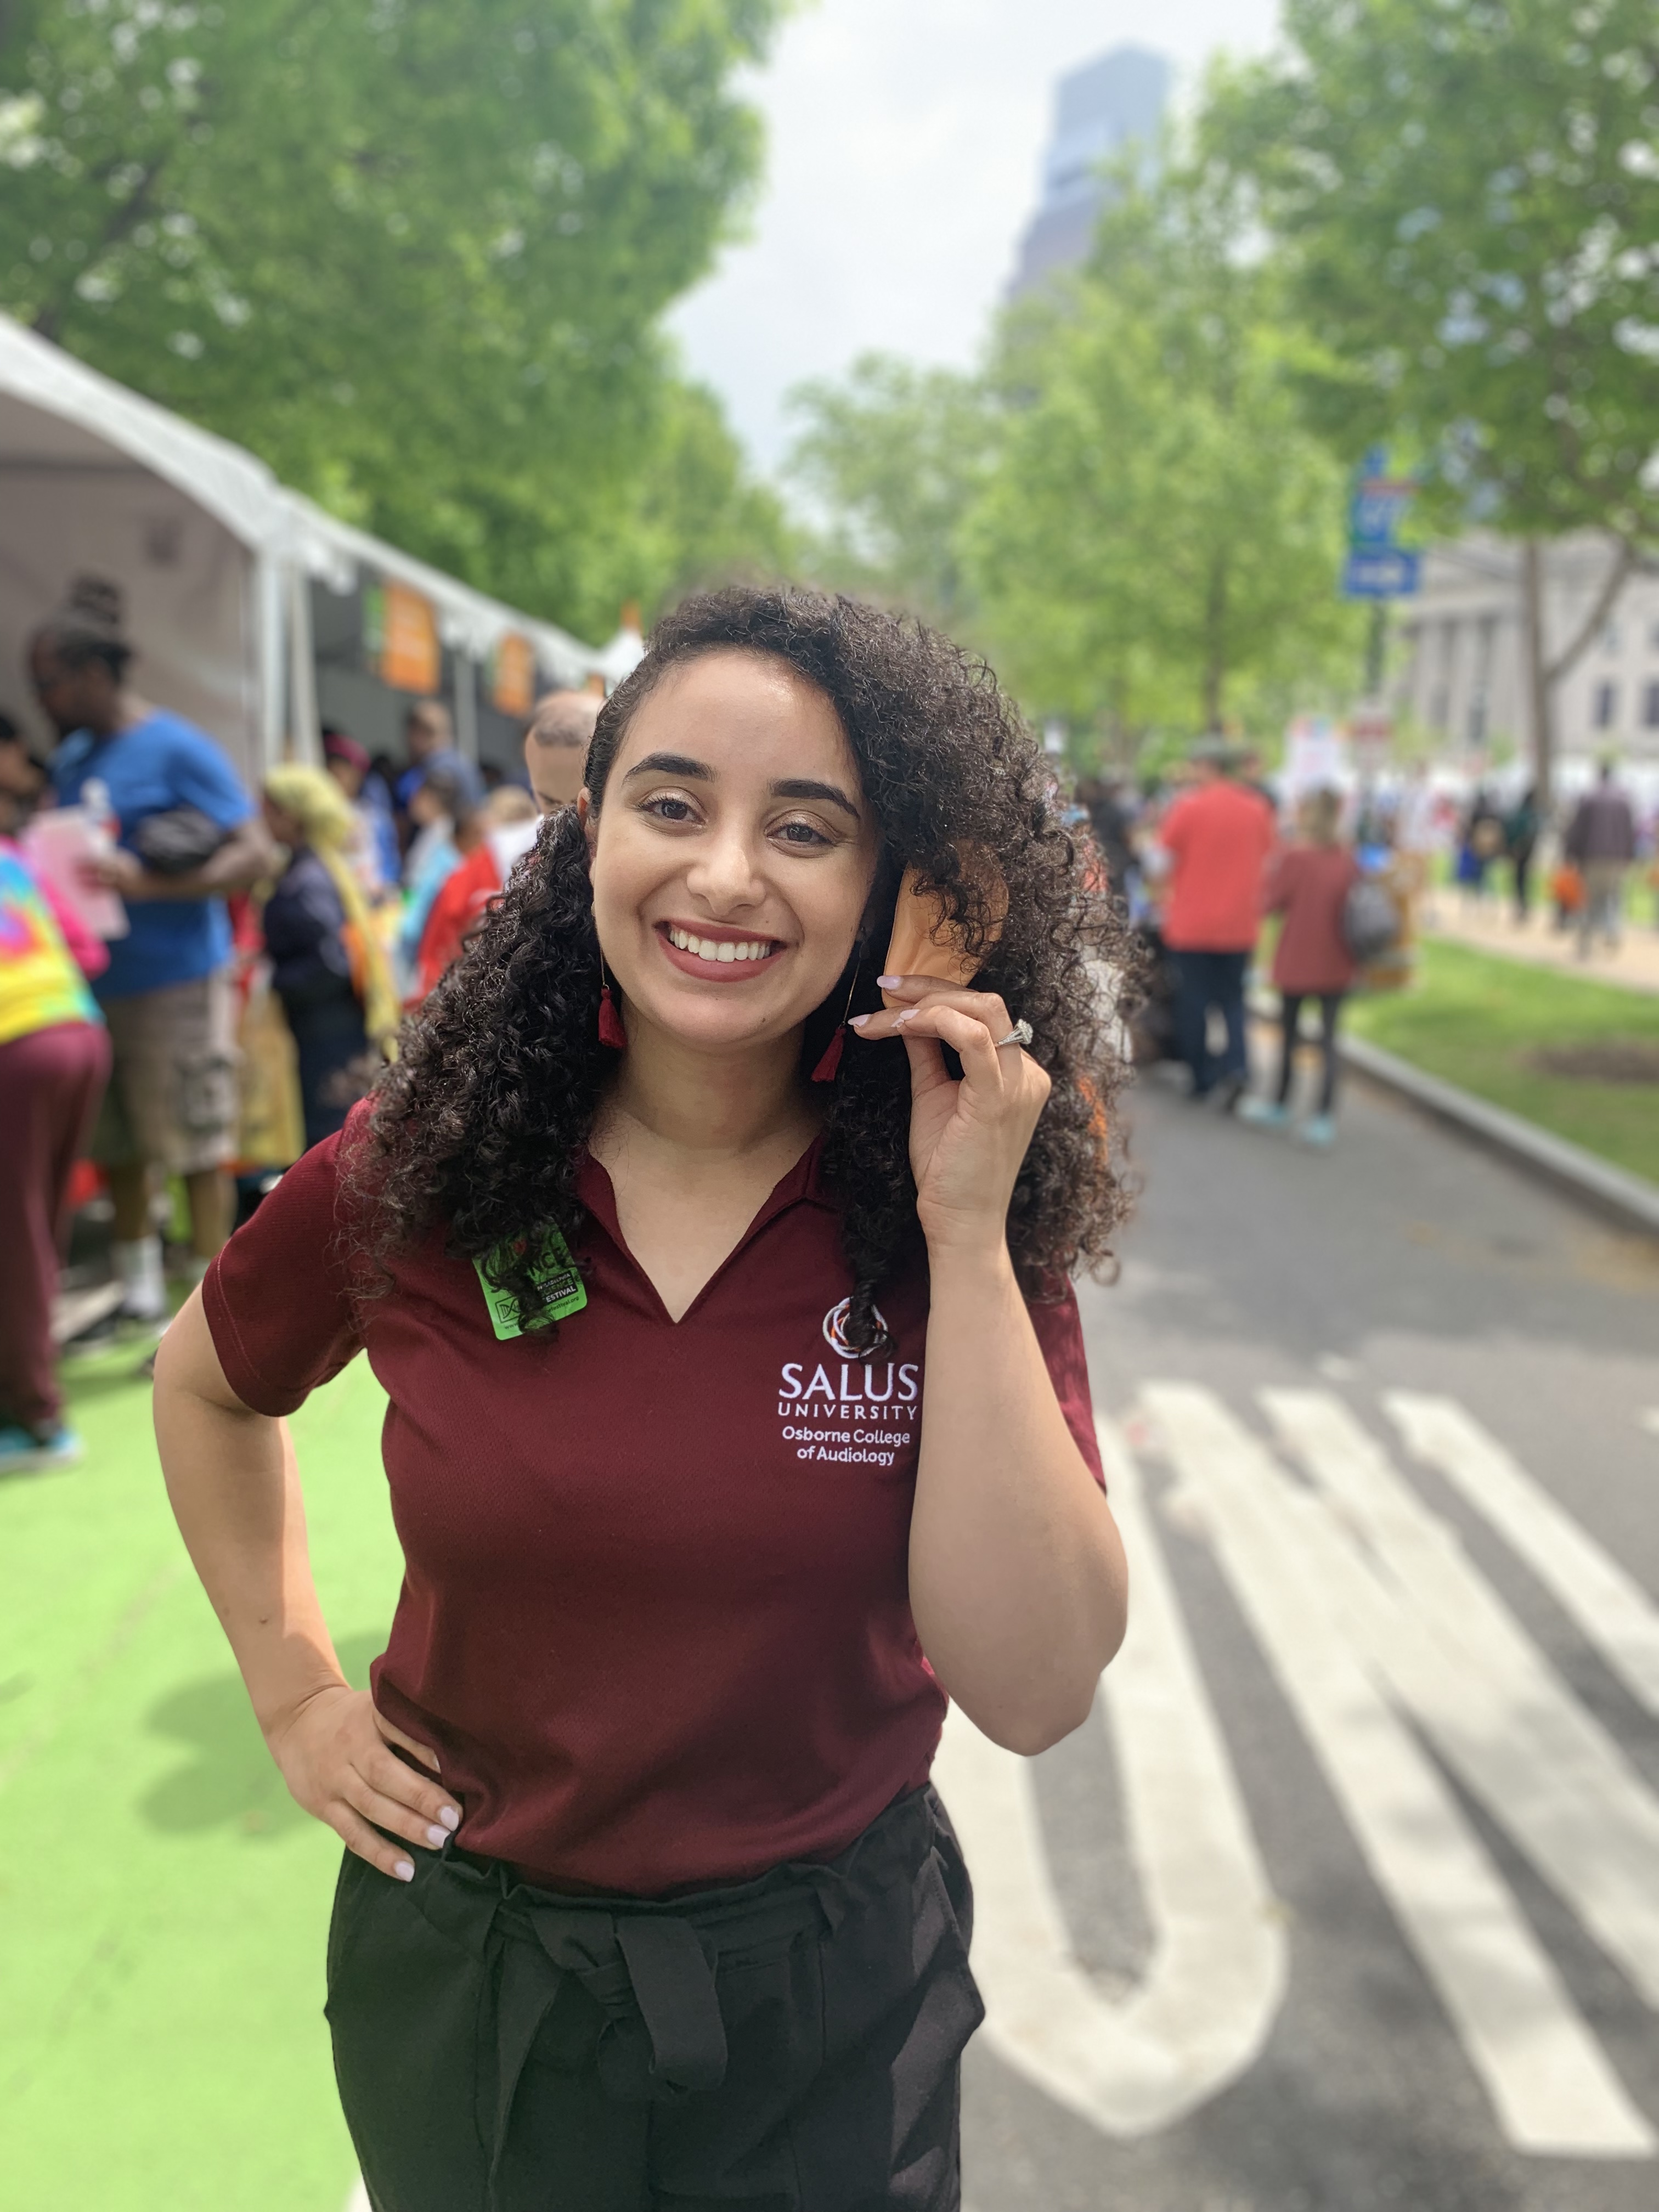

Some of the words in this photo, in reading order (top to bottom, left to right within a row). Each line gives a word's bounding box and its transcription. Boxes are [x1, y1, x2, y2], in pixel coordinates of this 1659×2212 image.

[537, 1273, 571, 1291] PHLADELPHIA
[541, 1286, 576, 1303] ESTIVAL
[778, 1362, 919, 1402] SALUS
[777, 1402, 918, 1420] UNIVERSITY
[782, 1426, 850, 1443] Osborne
[853, 1429, 910, 1447] College
[797, 1446, 816, 1459] of
[816, 1446, 895, 1466] Audiology
